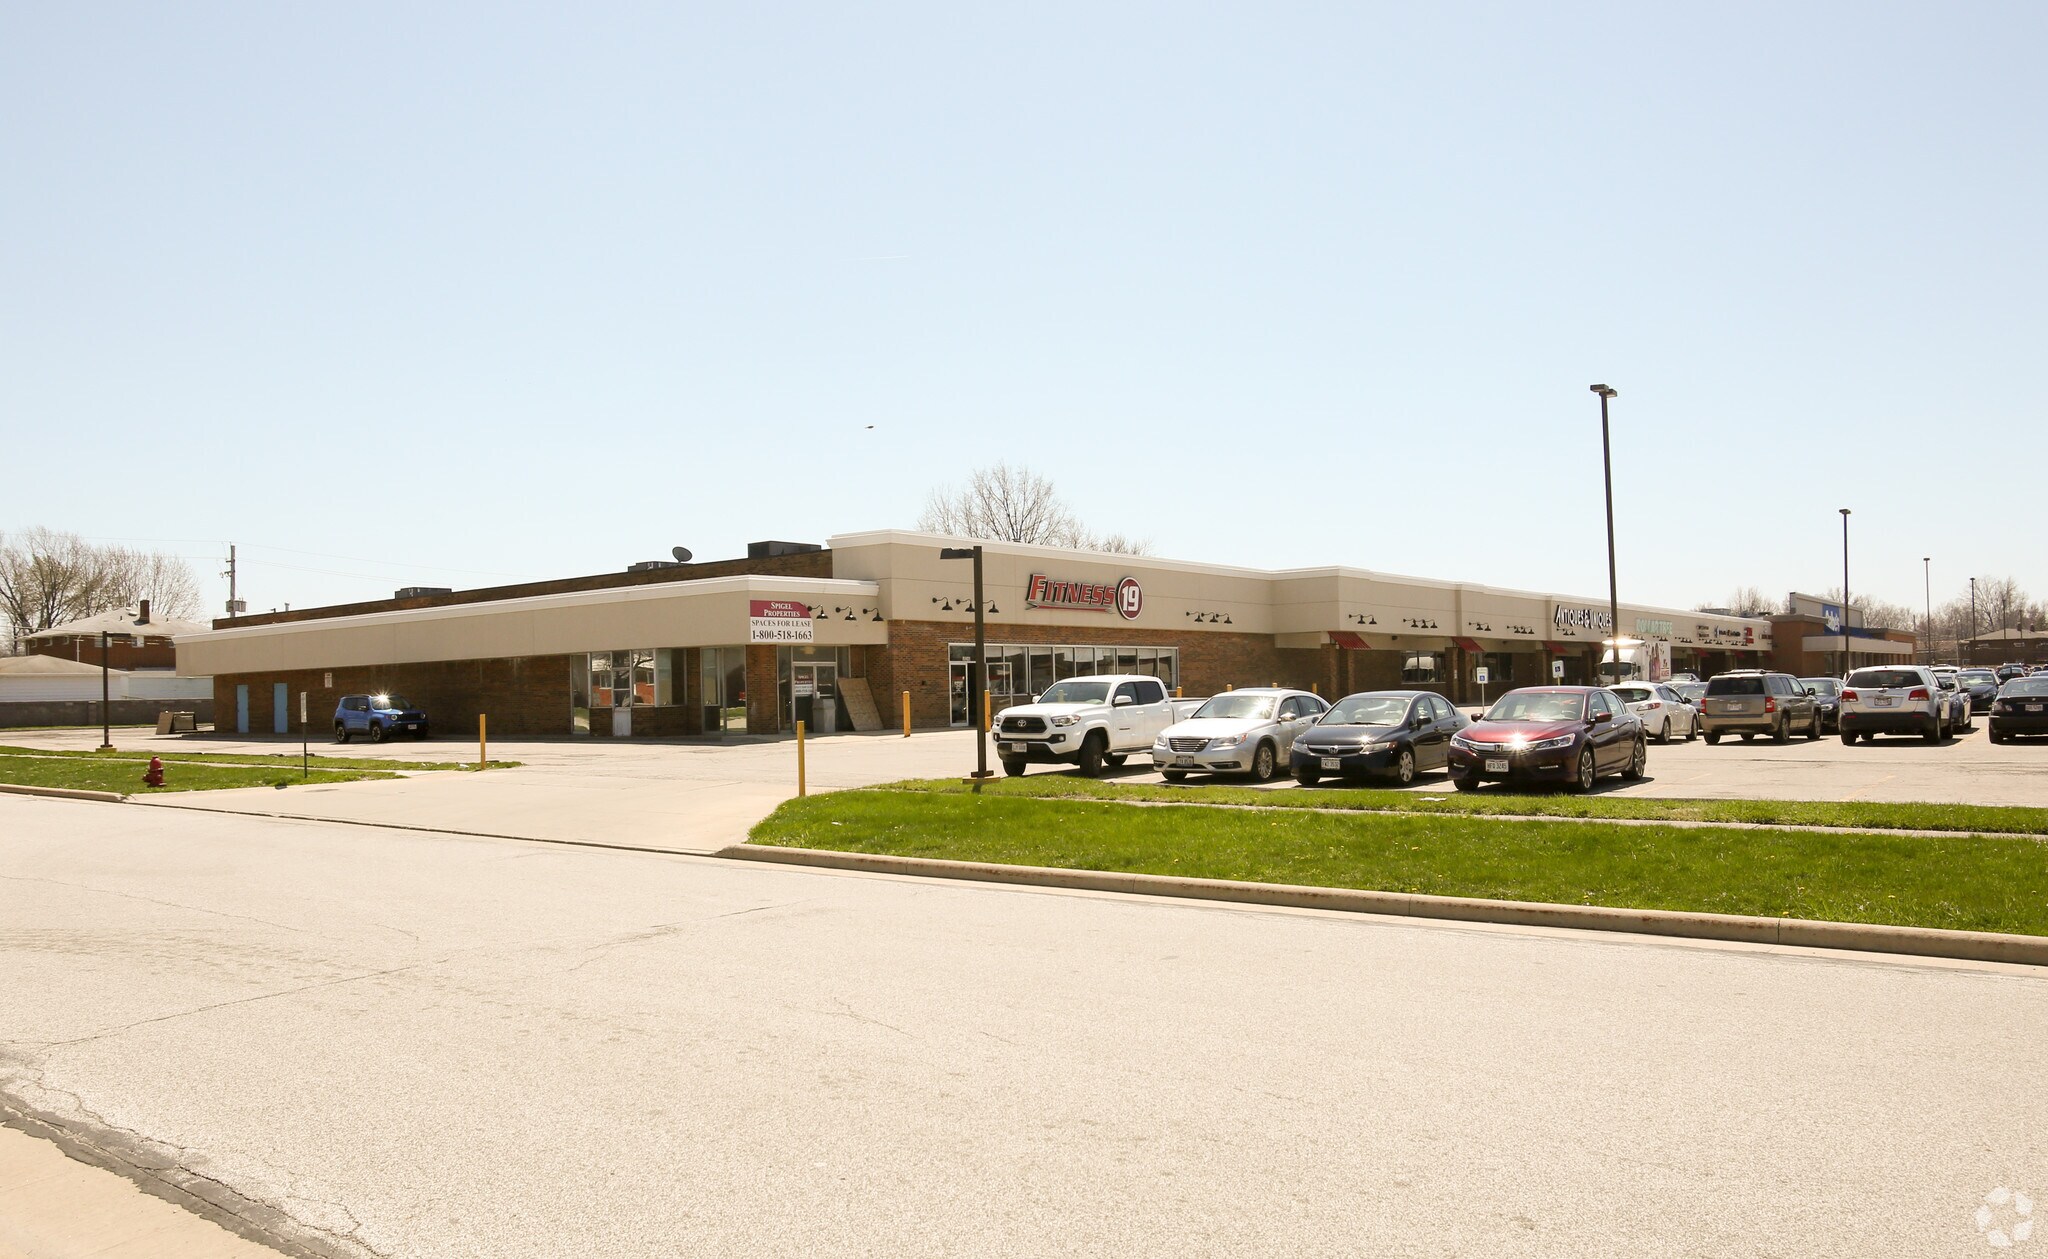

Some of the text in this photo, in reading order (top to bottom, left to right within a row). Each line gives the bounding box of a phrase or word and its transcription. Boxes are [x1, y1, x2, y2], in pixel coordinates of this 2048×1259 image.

[1122, 585, 1140, 611] 19
[771, 602, 793, 610] SPIGEL
[763, 609, 800, 617] PROPERTIES
[751, 619, 776, 627] SPACES
[752, 630, 812, 640] 1-800-518-1663
